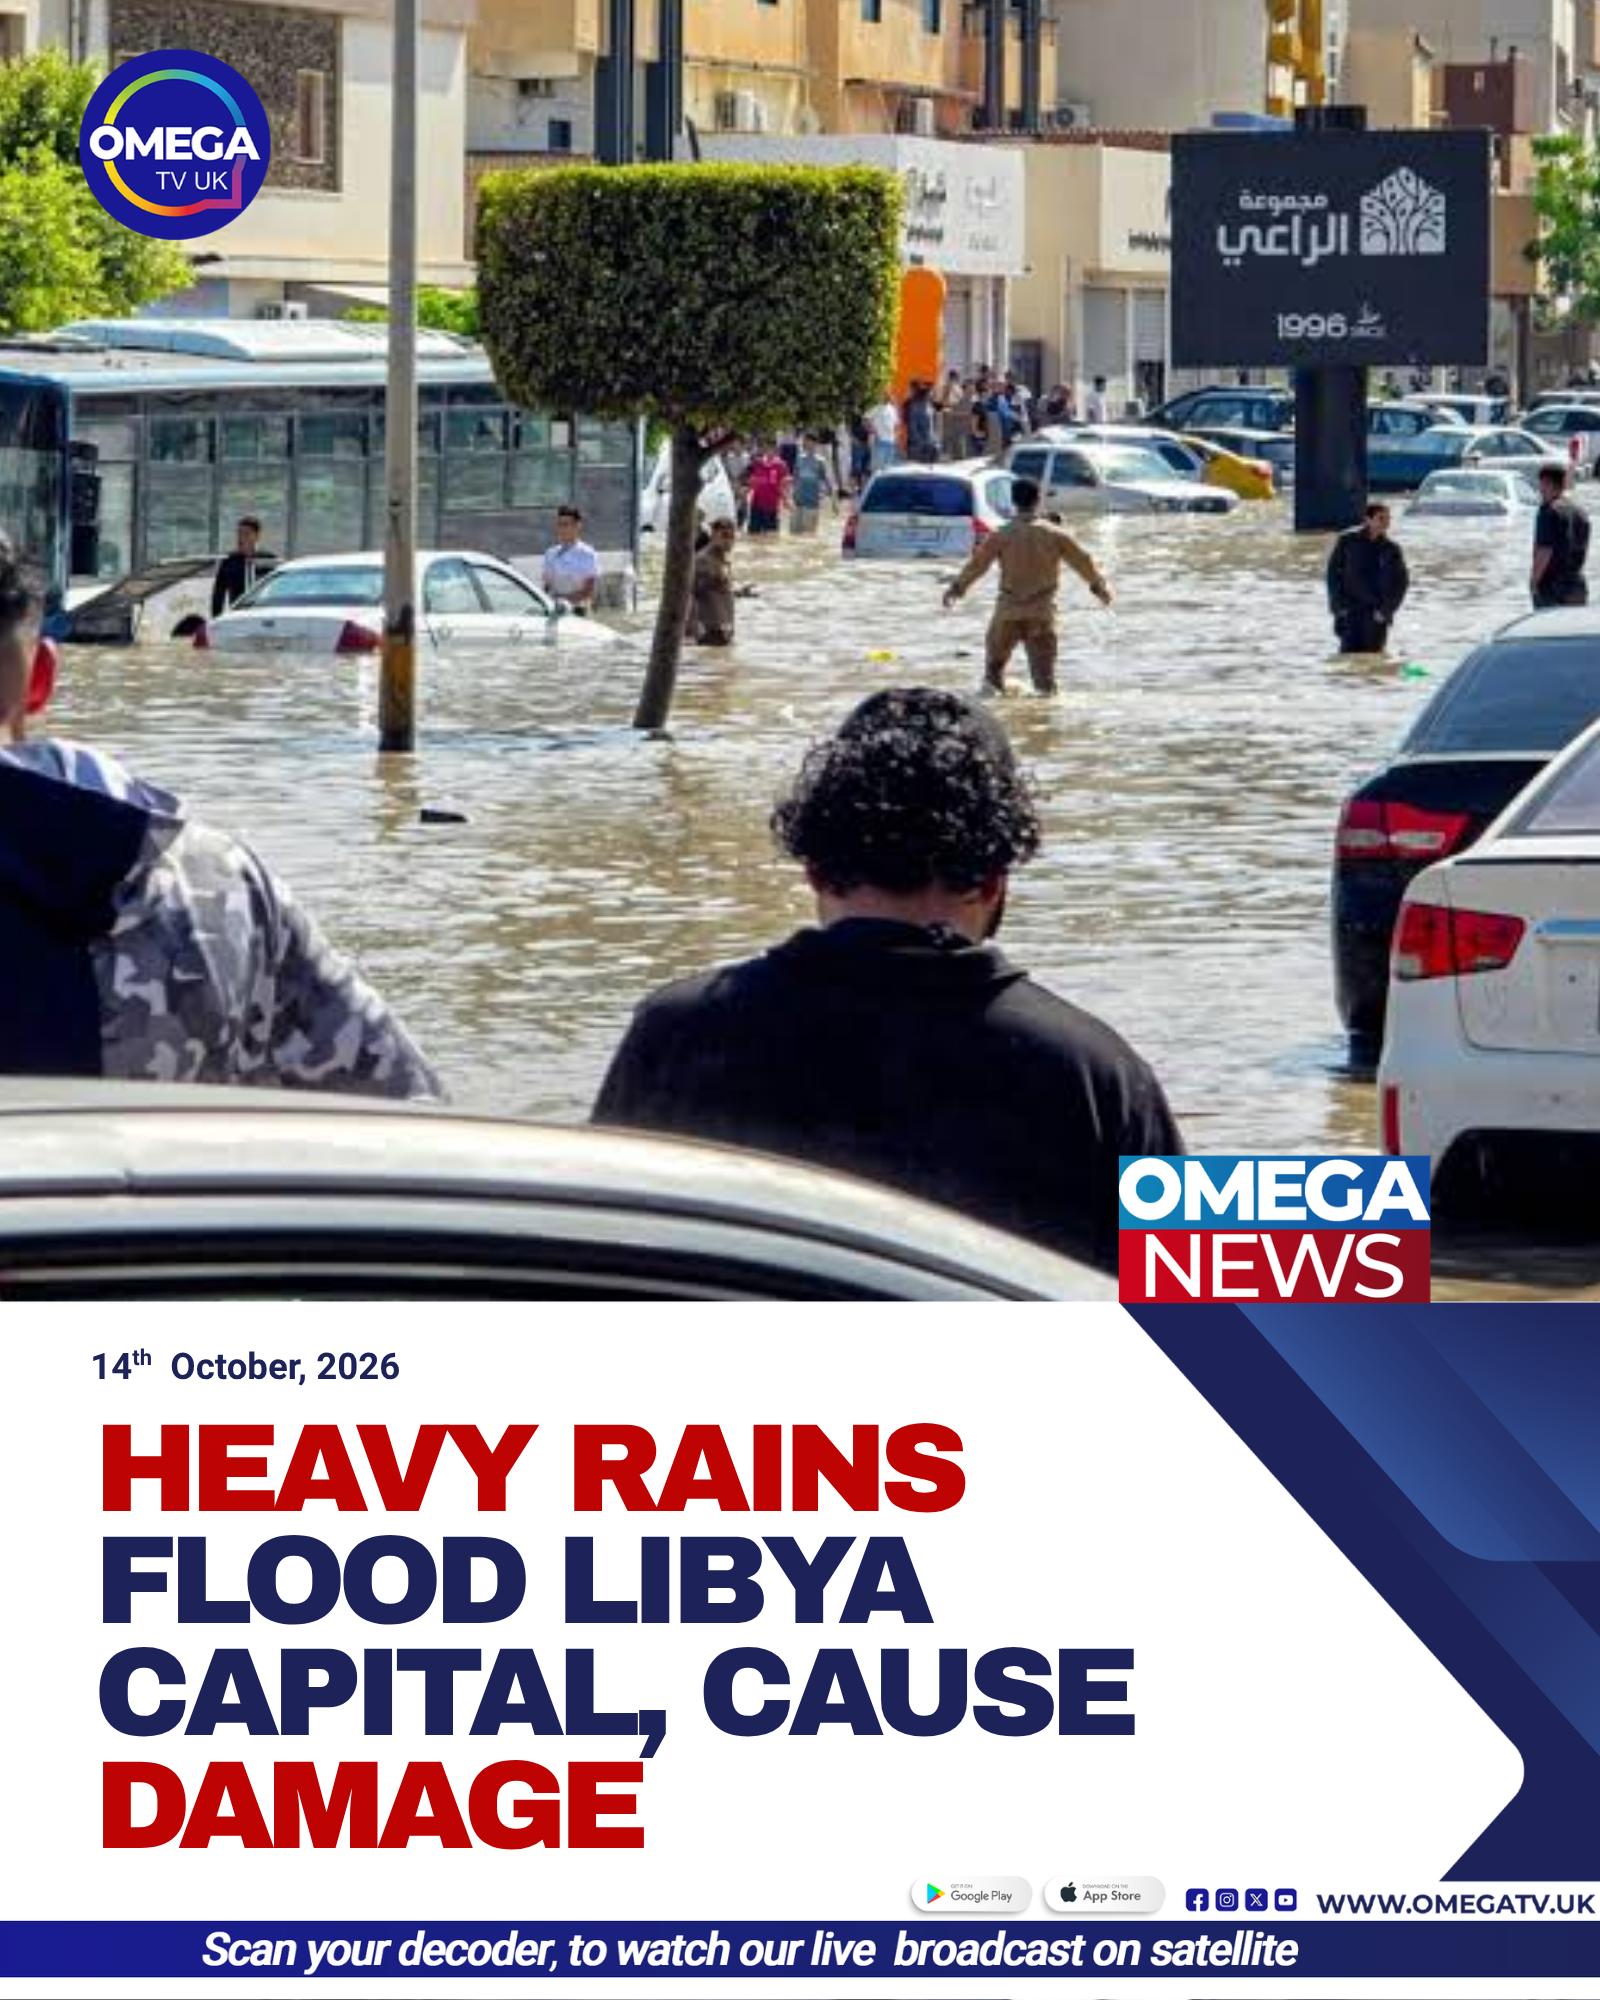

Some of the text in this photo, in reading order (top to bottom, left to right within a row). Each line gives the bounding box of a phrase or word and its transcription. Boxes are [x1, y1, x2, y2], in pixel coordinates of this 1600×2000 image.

[1239, 189, 1329, 217] مجموعة
[1217, 212, 1349, 267] الراعي
[1277, 313, 1348, 339] 1996
